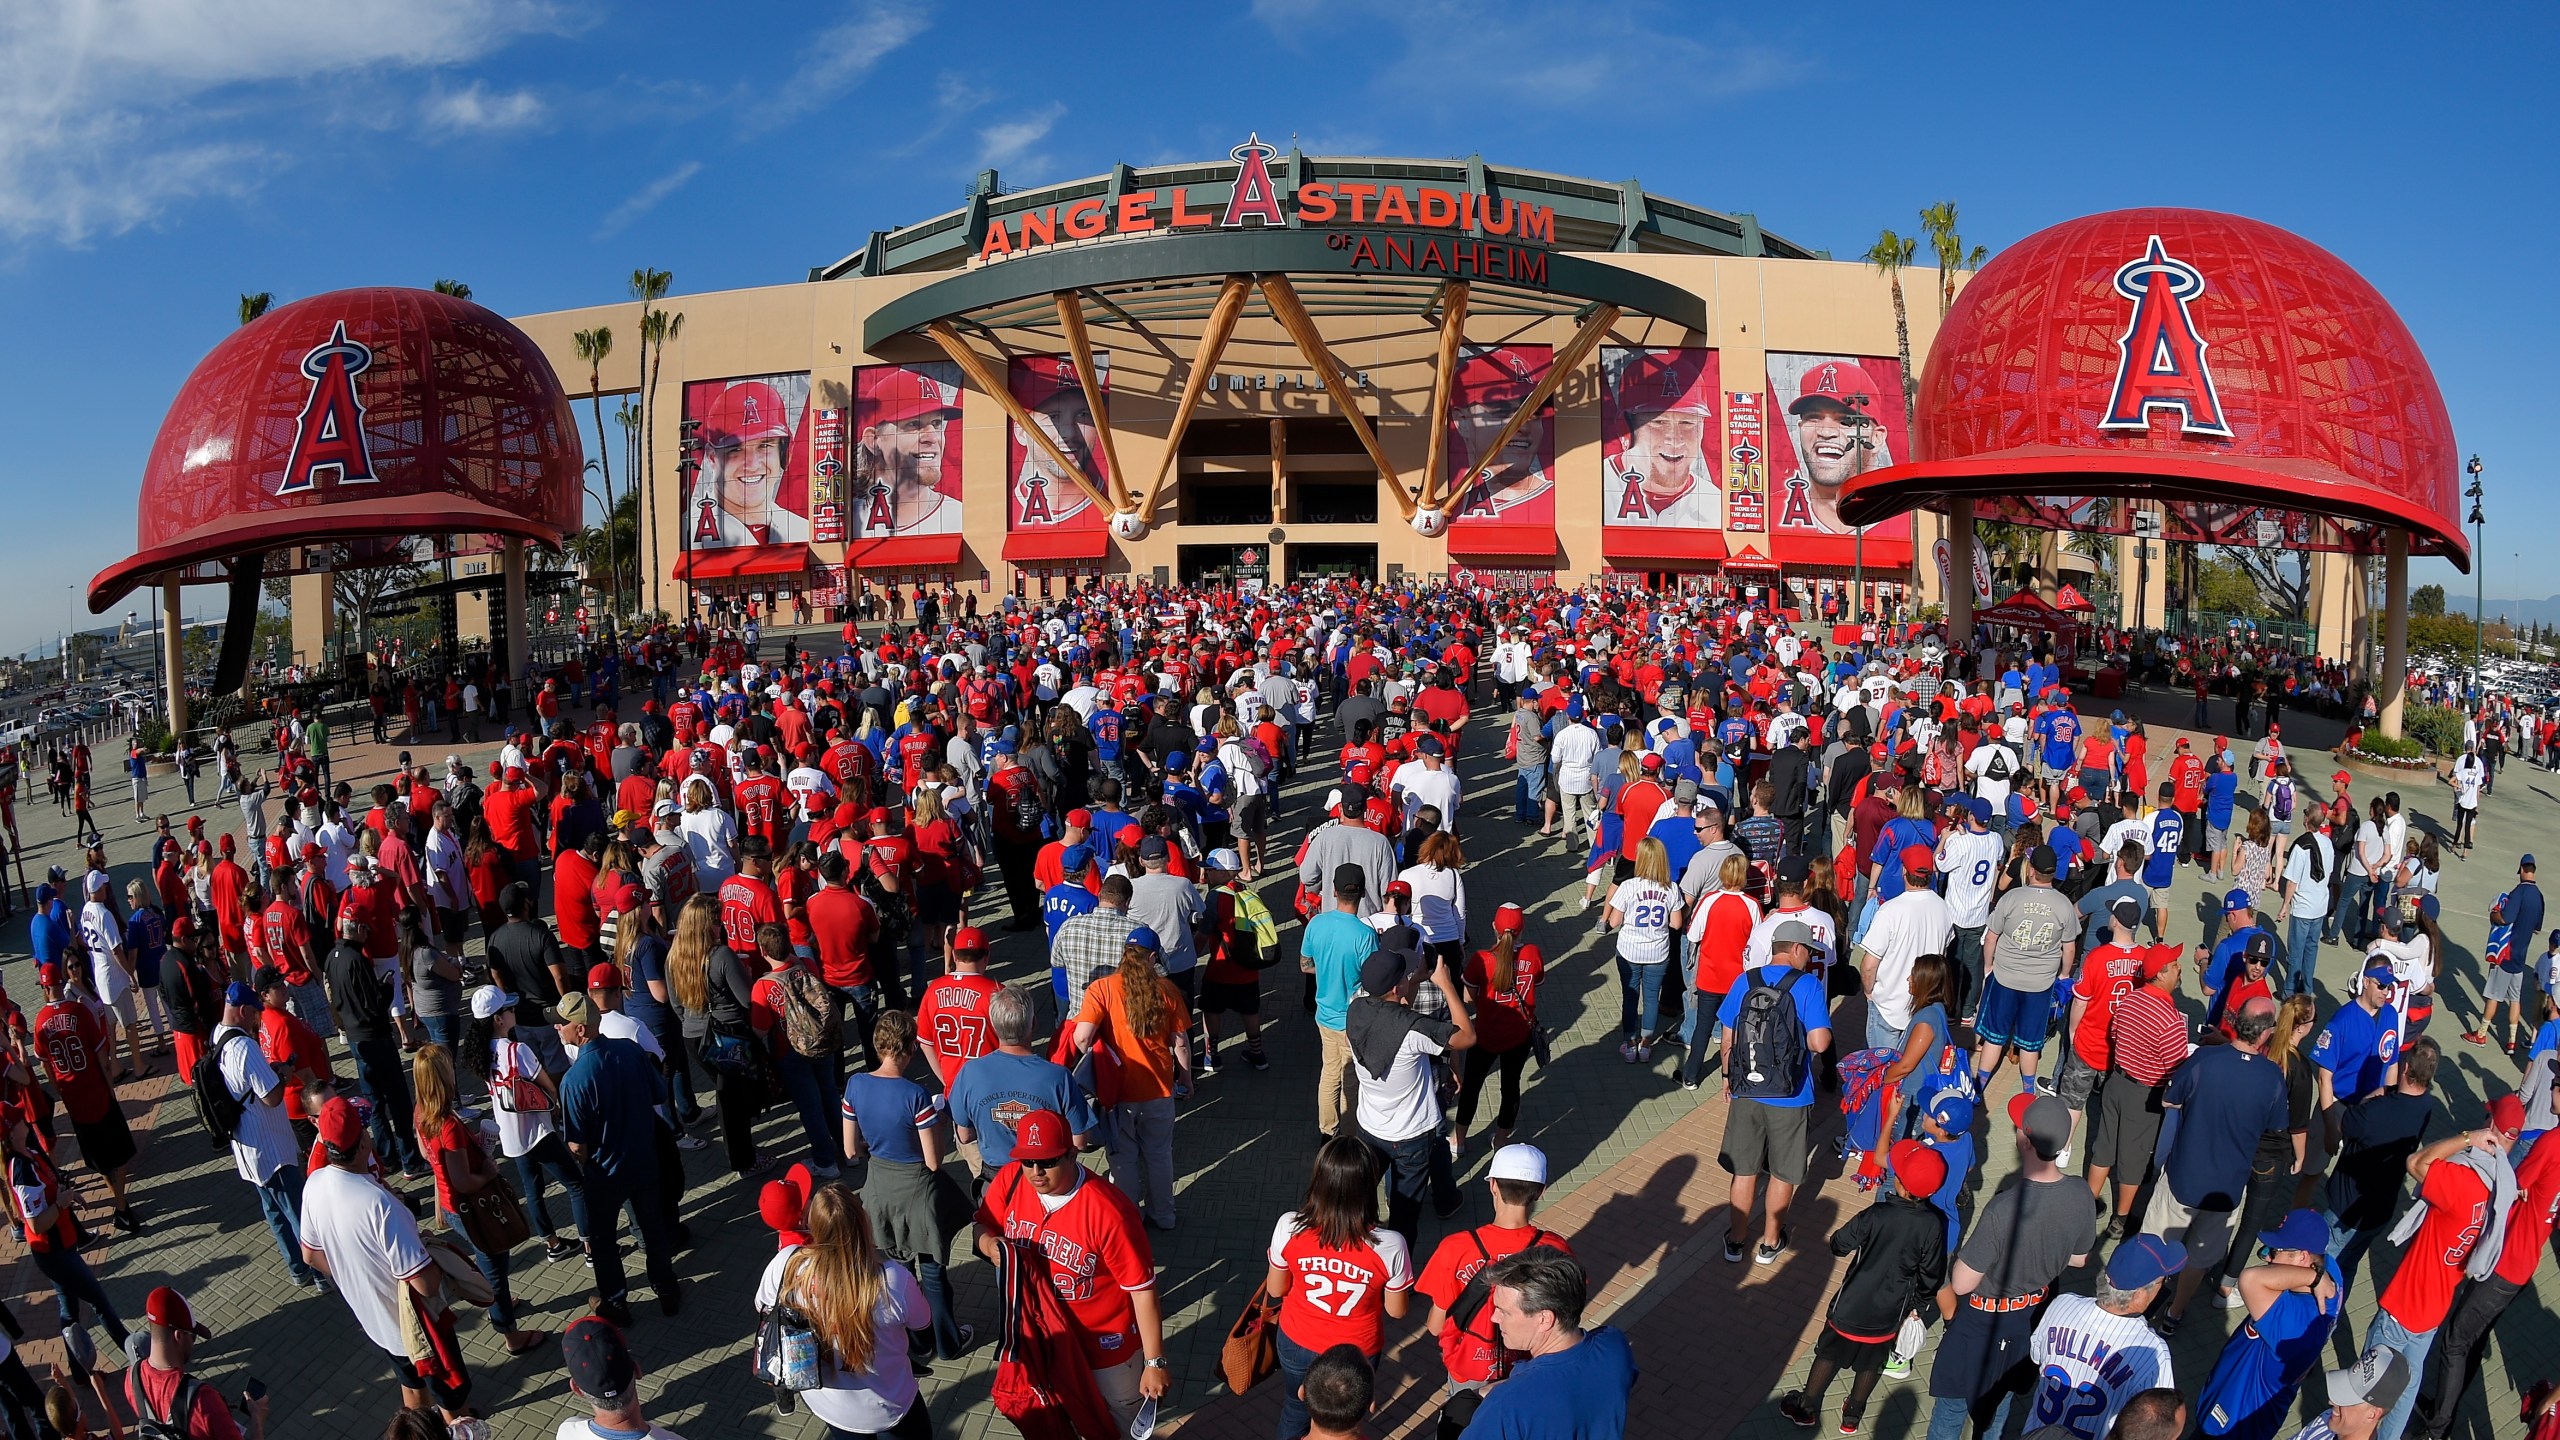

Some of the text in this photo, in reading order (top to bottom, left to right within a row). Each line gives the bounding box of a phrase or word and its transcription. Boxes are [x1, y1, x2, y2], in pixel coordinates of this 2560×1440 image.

[980, 188, 1212, 261] ANGEL
[1297, 182, 1556, 244] STADIUM
[1325, 232, 1551, 288] OF ANAHEIM
[1208, 371, 1369, 392] OMEPLAE
[1729, 421, 1760, 429] STADIUM
[1732, 414, 1756, 422] ANGEL
[818, 429, 840, 437] ANGEL
[2133, 545, 2158, 560] GTE
[1980, 615, 2004, 623] Delicious
[2004, 618, 2027, 626] Probiotic
[1872, 687, 1886, 701] 27
[675, 715, 692, 730] 27
[593, 735, 604, 752] 5
[1098, 726, 1119, 742] 49
[2054, 726, 2073, 743] 38
[834, 744, 859, 756] TROUT
[838, 755, 863, 780] 27
[911, 753, 923, 771] 5
[742, 784, 772, 800] TROUT
[790, 775, 811, 787] TROUT
[746, 798, 773, 827] 27
[2120, 828, 2148, 842] ARRIETA
[2157, 831, 2179, 853] 42
[660, 852, 687, 873] TROUT
[1971, 859, 1991, 886] 8
[668, 867, 694, 903] 27
[721, 883, 754, 907] HUNTER
[1636, 891, 1668, 904] LAURIE
[266, 911, 283, 923] TROUT
[720, 906, 756, 944] 48
[1635, 905, 1665, 928] 23
[82, 926, 103, 953] 22
[266, 925, 284, 951] 27
[2011, 919, 2055, 952] 44
[935, 986, 982, 1012] TROUT
[936, 1014, 986, 1060] 27
[49, 1034, 87, 1075] 36
[979, 1092, 1007, 1108] VEHICLE
[1004, 1209, 1097, 1277] ANGELS
[1297, 1256, 1374, 1285] TROUT
[1053, 1273, 1096, 1301] 27
[1304, 1273, 1368, 1318] 27
[2046, 1325, 2135, 1389] PULLMAN
[2034, 1364, 2109, 1440] 32
